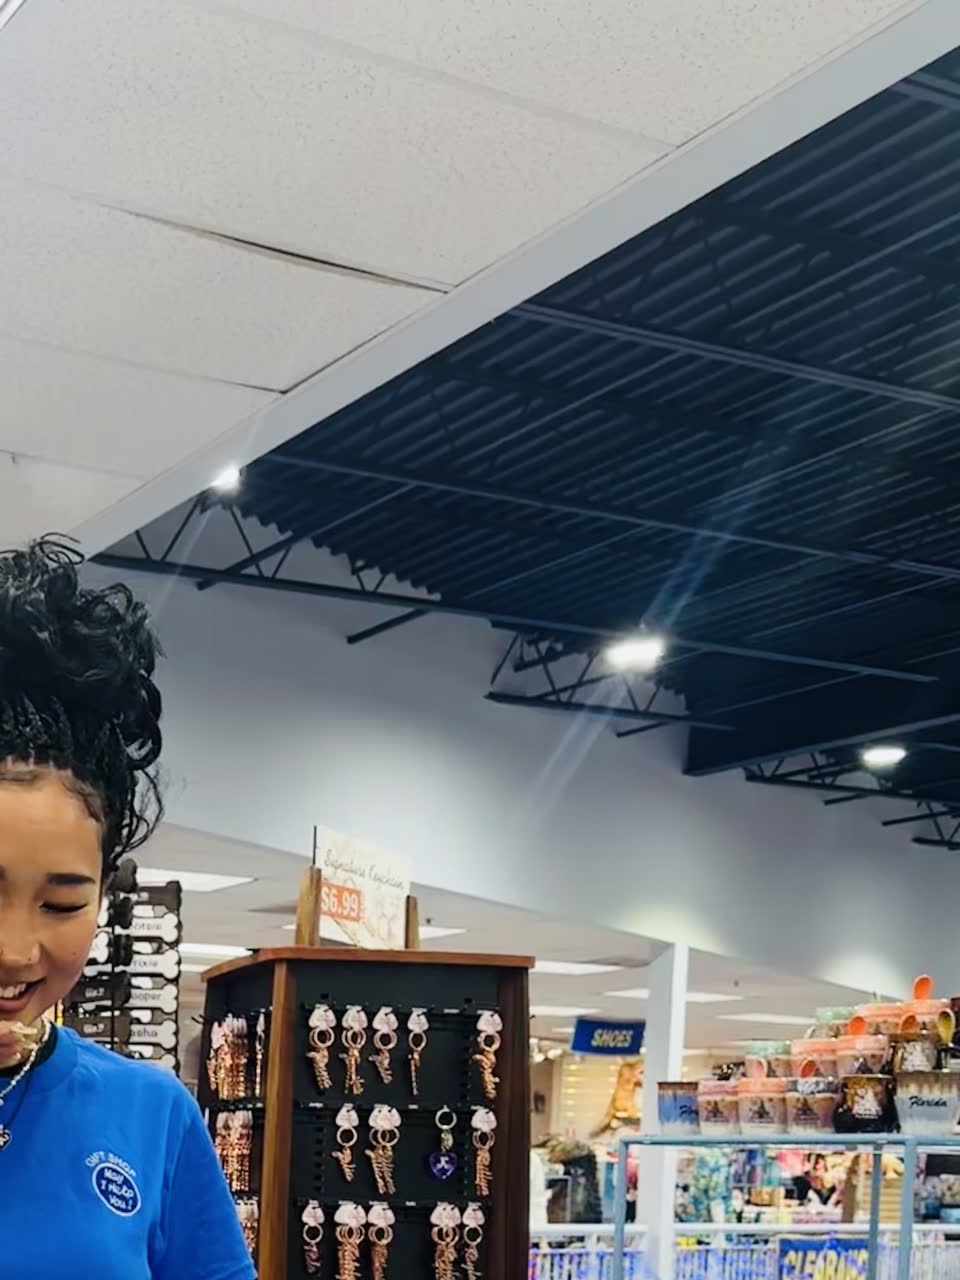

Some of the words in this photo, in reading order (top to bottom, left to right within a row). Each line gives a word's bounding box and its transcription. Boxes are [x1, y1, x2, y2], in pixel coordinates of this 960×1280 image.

[321, 885, 360, 918] $6.99
[590, 1028, 634, 1049] SHOES
[908, 1095, 948, 1109] Florida
